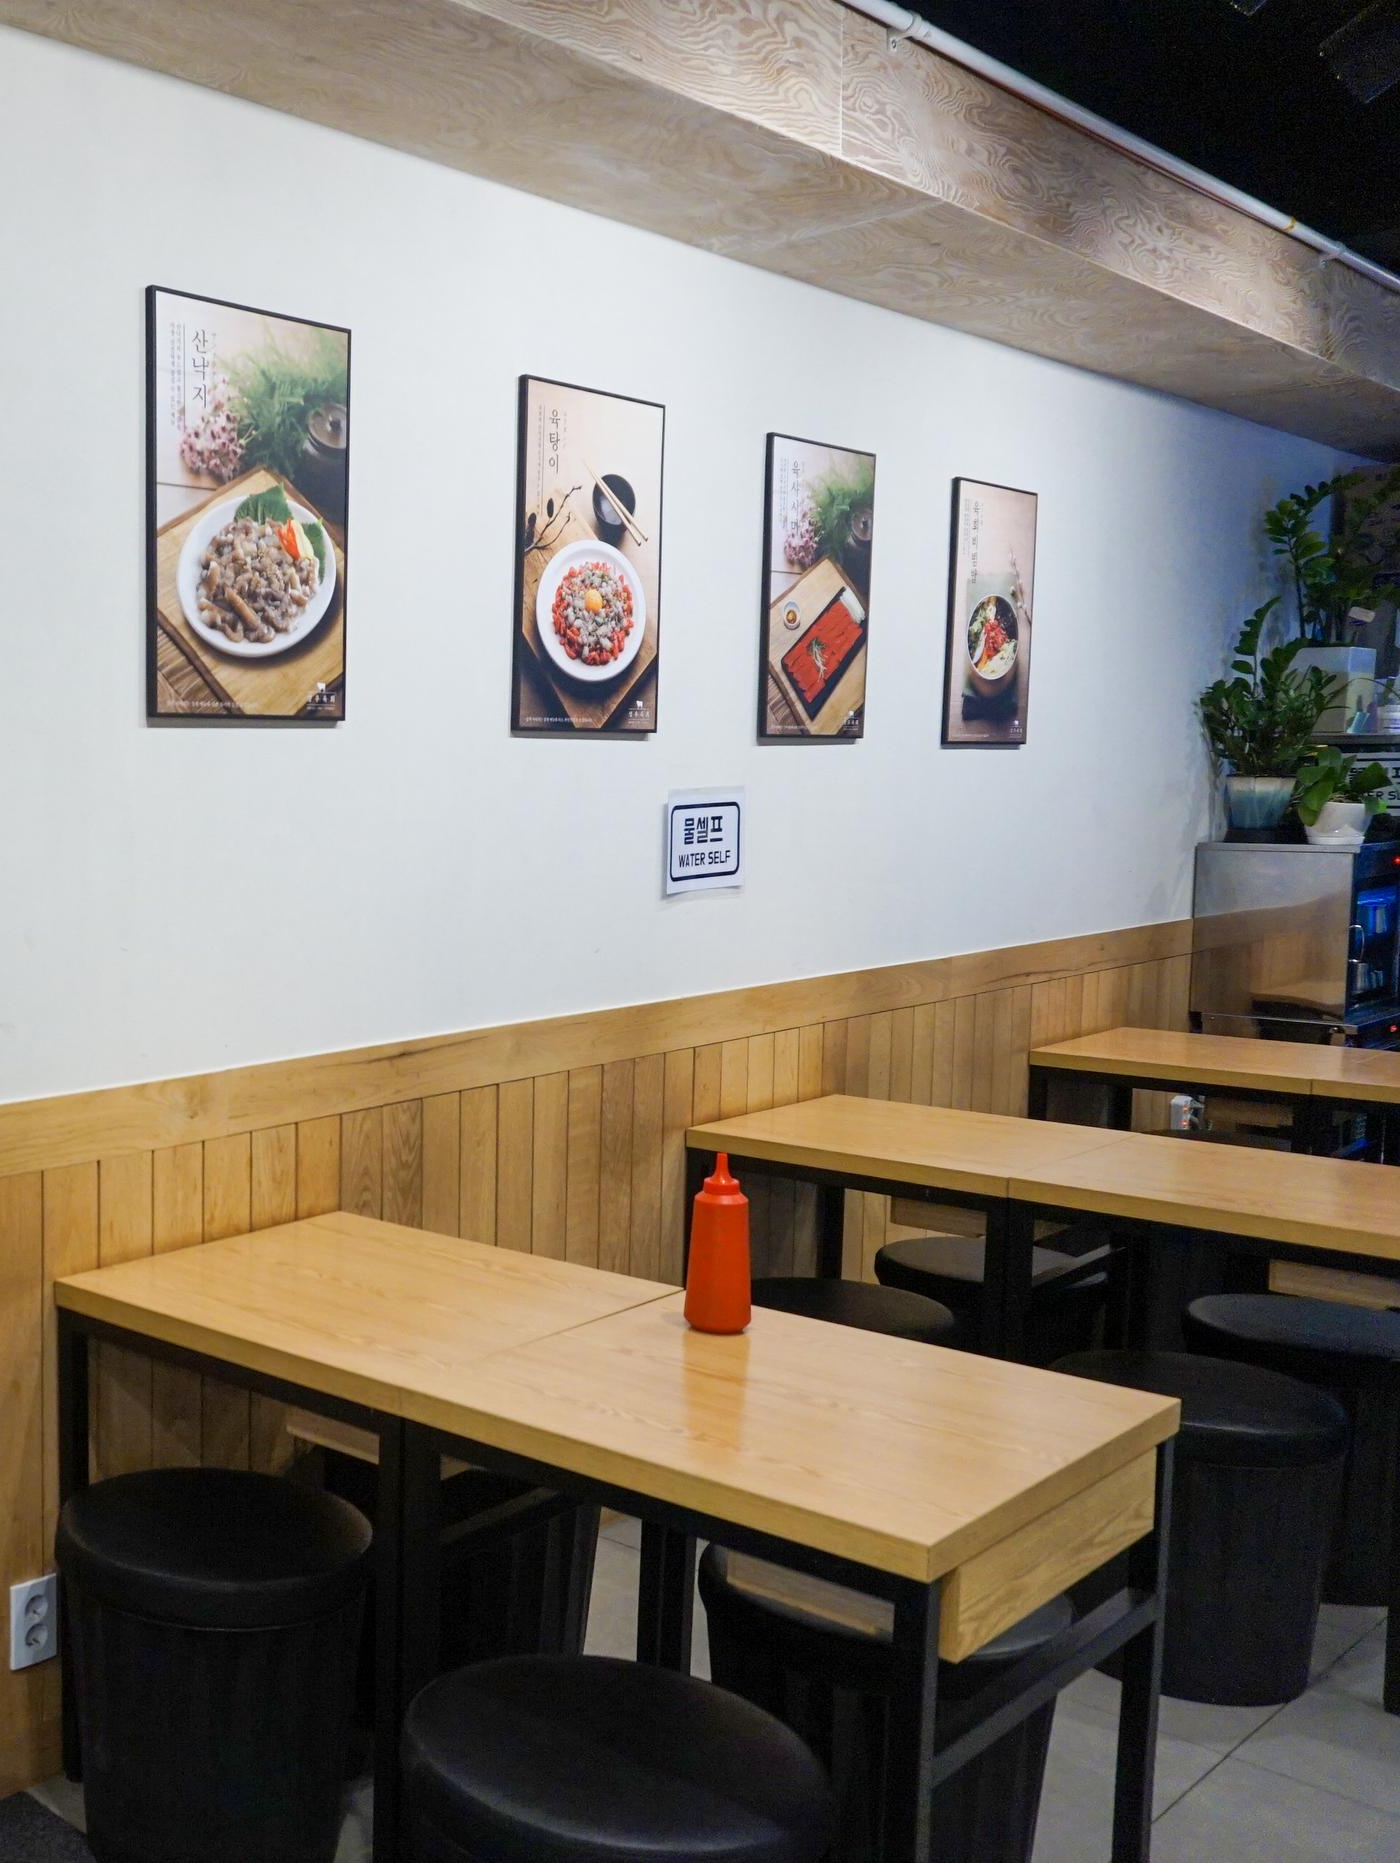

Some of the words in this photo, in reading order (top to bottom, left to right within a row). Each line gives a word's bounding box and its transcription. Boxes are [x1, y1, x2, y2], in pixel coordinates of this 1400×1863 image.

[192, 329, 209, 409] 산낙지
[549, 408, 561, 474] 육탕이
[683, 815, 723, 845] 물셀프
[678, 852, 706, 868] WATER
[707, 849, 731, 865] SELF
